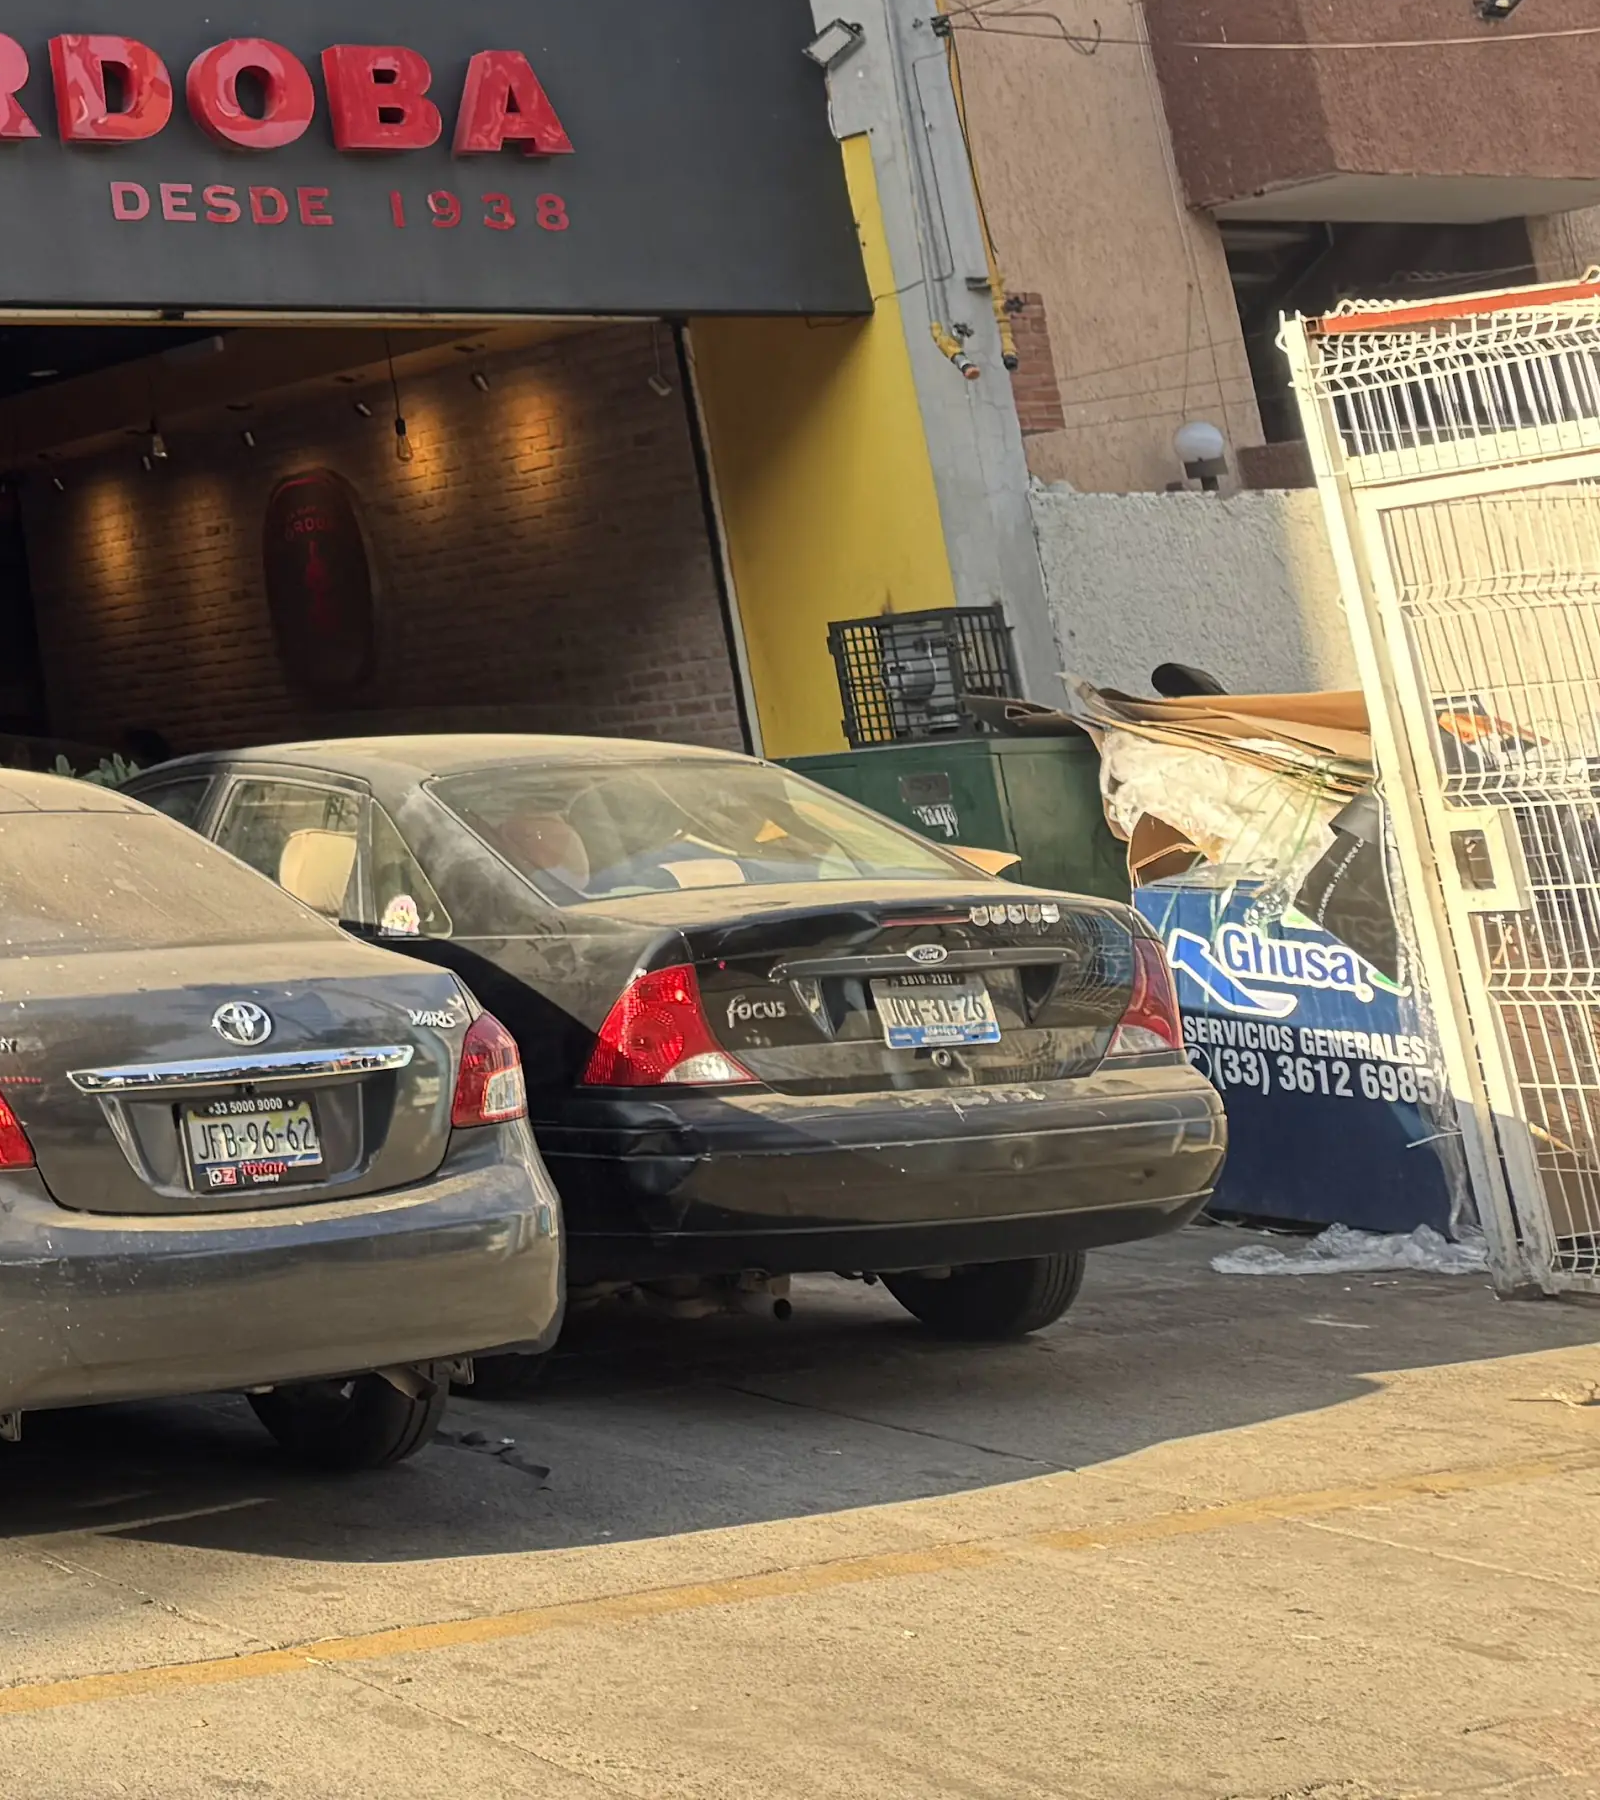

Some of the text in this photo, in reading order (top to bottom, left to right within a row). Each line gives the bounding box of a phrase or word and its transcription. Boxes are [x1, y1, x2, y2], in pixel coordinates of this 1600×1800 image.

[109, 179, 571, 232] DESDE 1938
[406, 1008, 457, 1028] YARIS
[1183, 1015, 1427, 1065] SERVICIOS GENERALES
[1214, 1048, 1438, 1105] (33) 3612 6985
[214, 1102, 228, 1115] 33
[230, 1099, 256, 1114] 5000
[198, 1116, 316, 1160] JFB-96-62
[240, 1160, 288, 1176] TOYOTA
